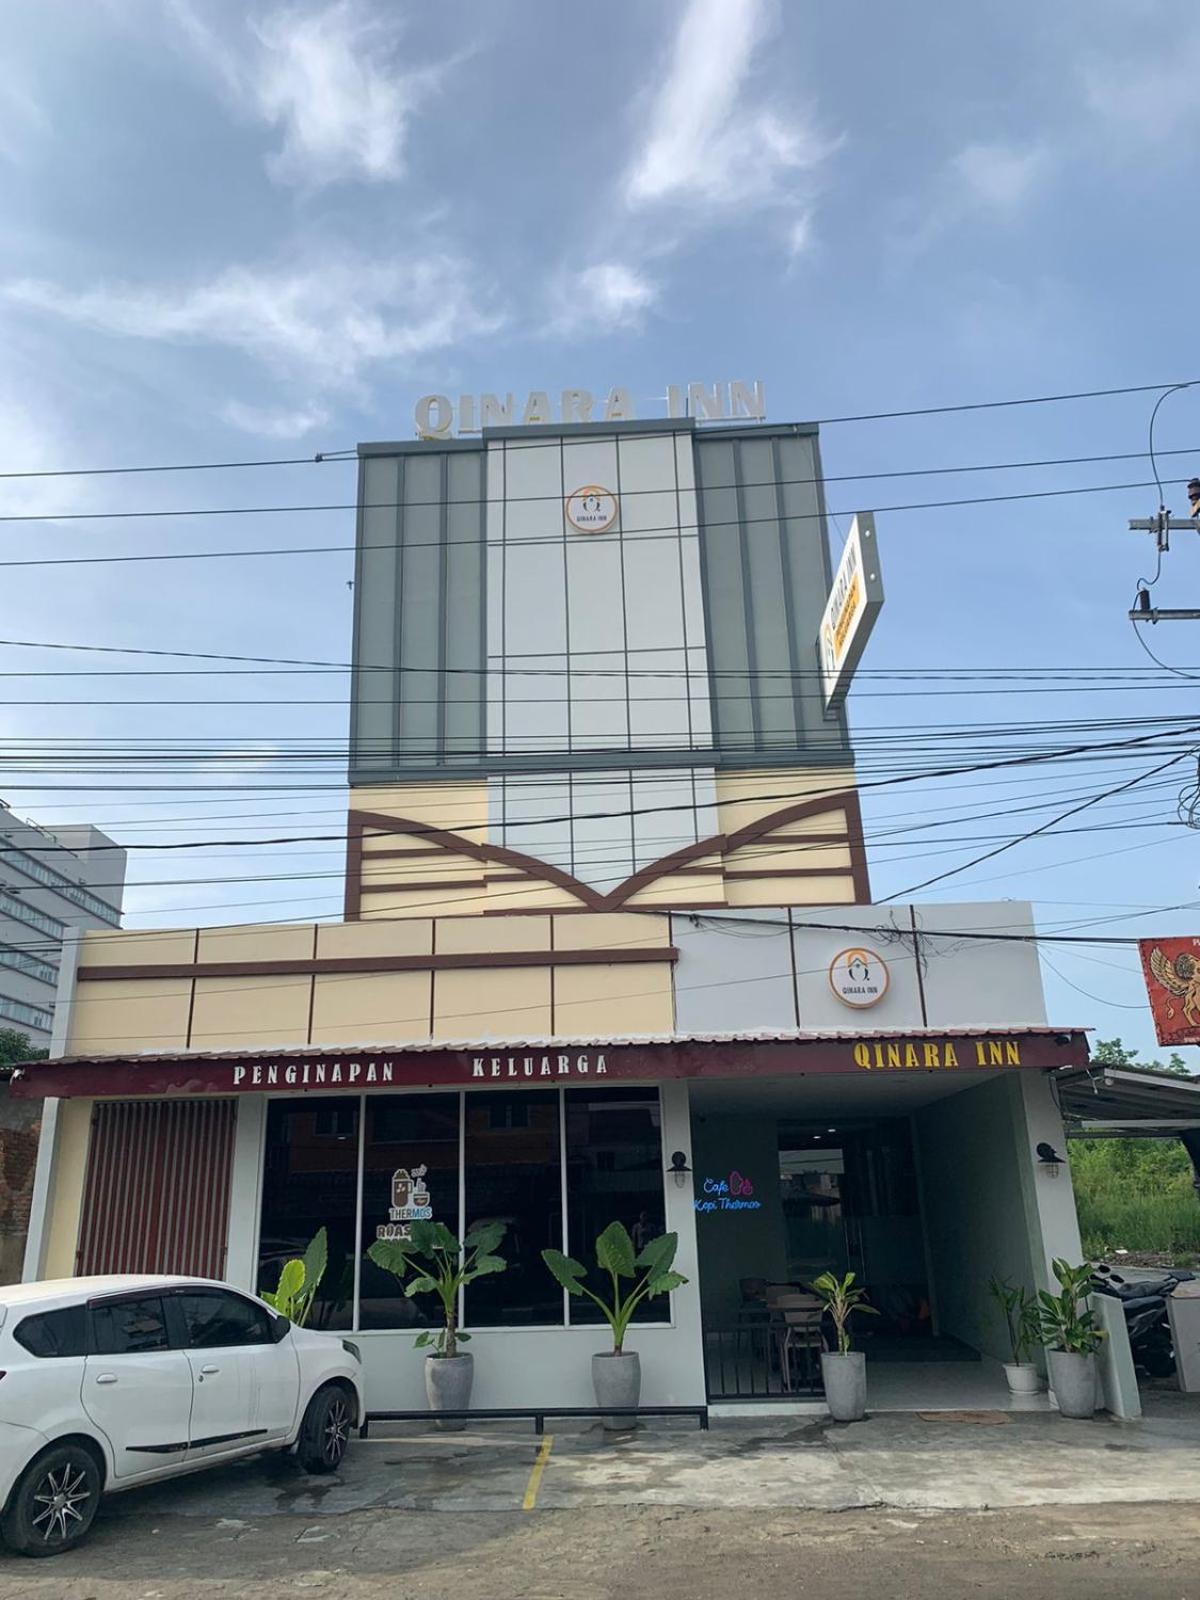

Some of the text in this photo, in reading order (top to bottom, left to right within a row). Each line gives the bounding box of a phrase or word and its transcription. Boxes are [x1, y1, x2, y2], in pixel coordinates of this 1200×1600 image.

[415, 381, 765, 439] QINARA INN
[842, 986, 878, 995] QINARA INN
[854, 1041, 1022, 1070] QINARA INN
[233, 1055, 608, 1086] PENGINAPAN KELUARGA
[703, 1176, 729, 1195] Cafe
[390, 1207, 432, 1219] THERMOS
[377, 1224, 412, 1239] ROAS
